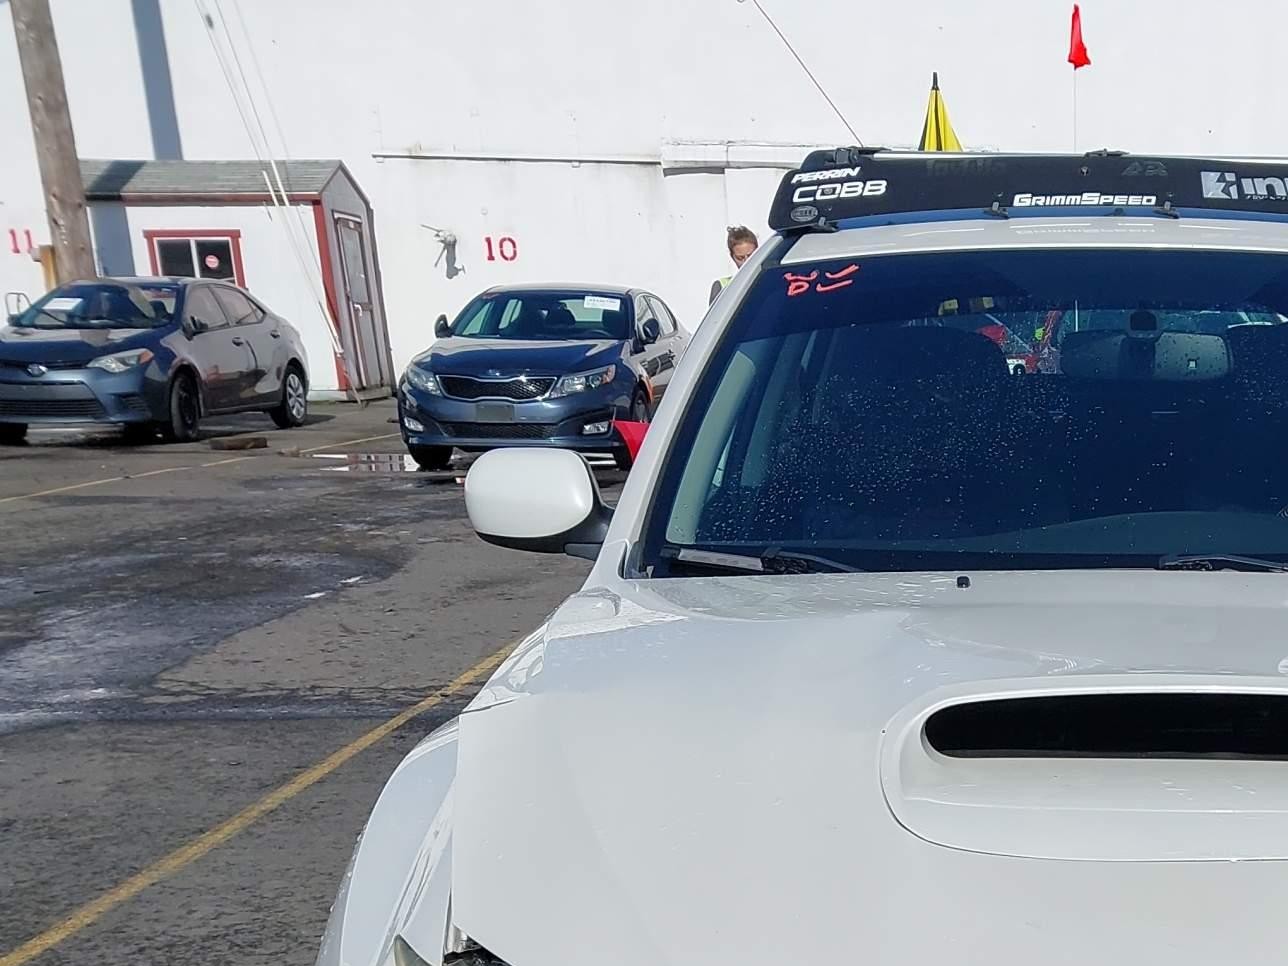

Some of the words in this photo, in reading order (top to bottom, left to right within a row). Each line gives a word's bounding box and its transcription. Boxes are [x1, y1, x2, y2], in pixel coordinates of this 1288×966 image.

[791, 166, 861, 184] PERRIN
[792, 180, 888, 202] COBB
[9, 228, 33, 255] 11
[485, 236, 518, 262] 10
